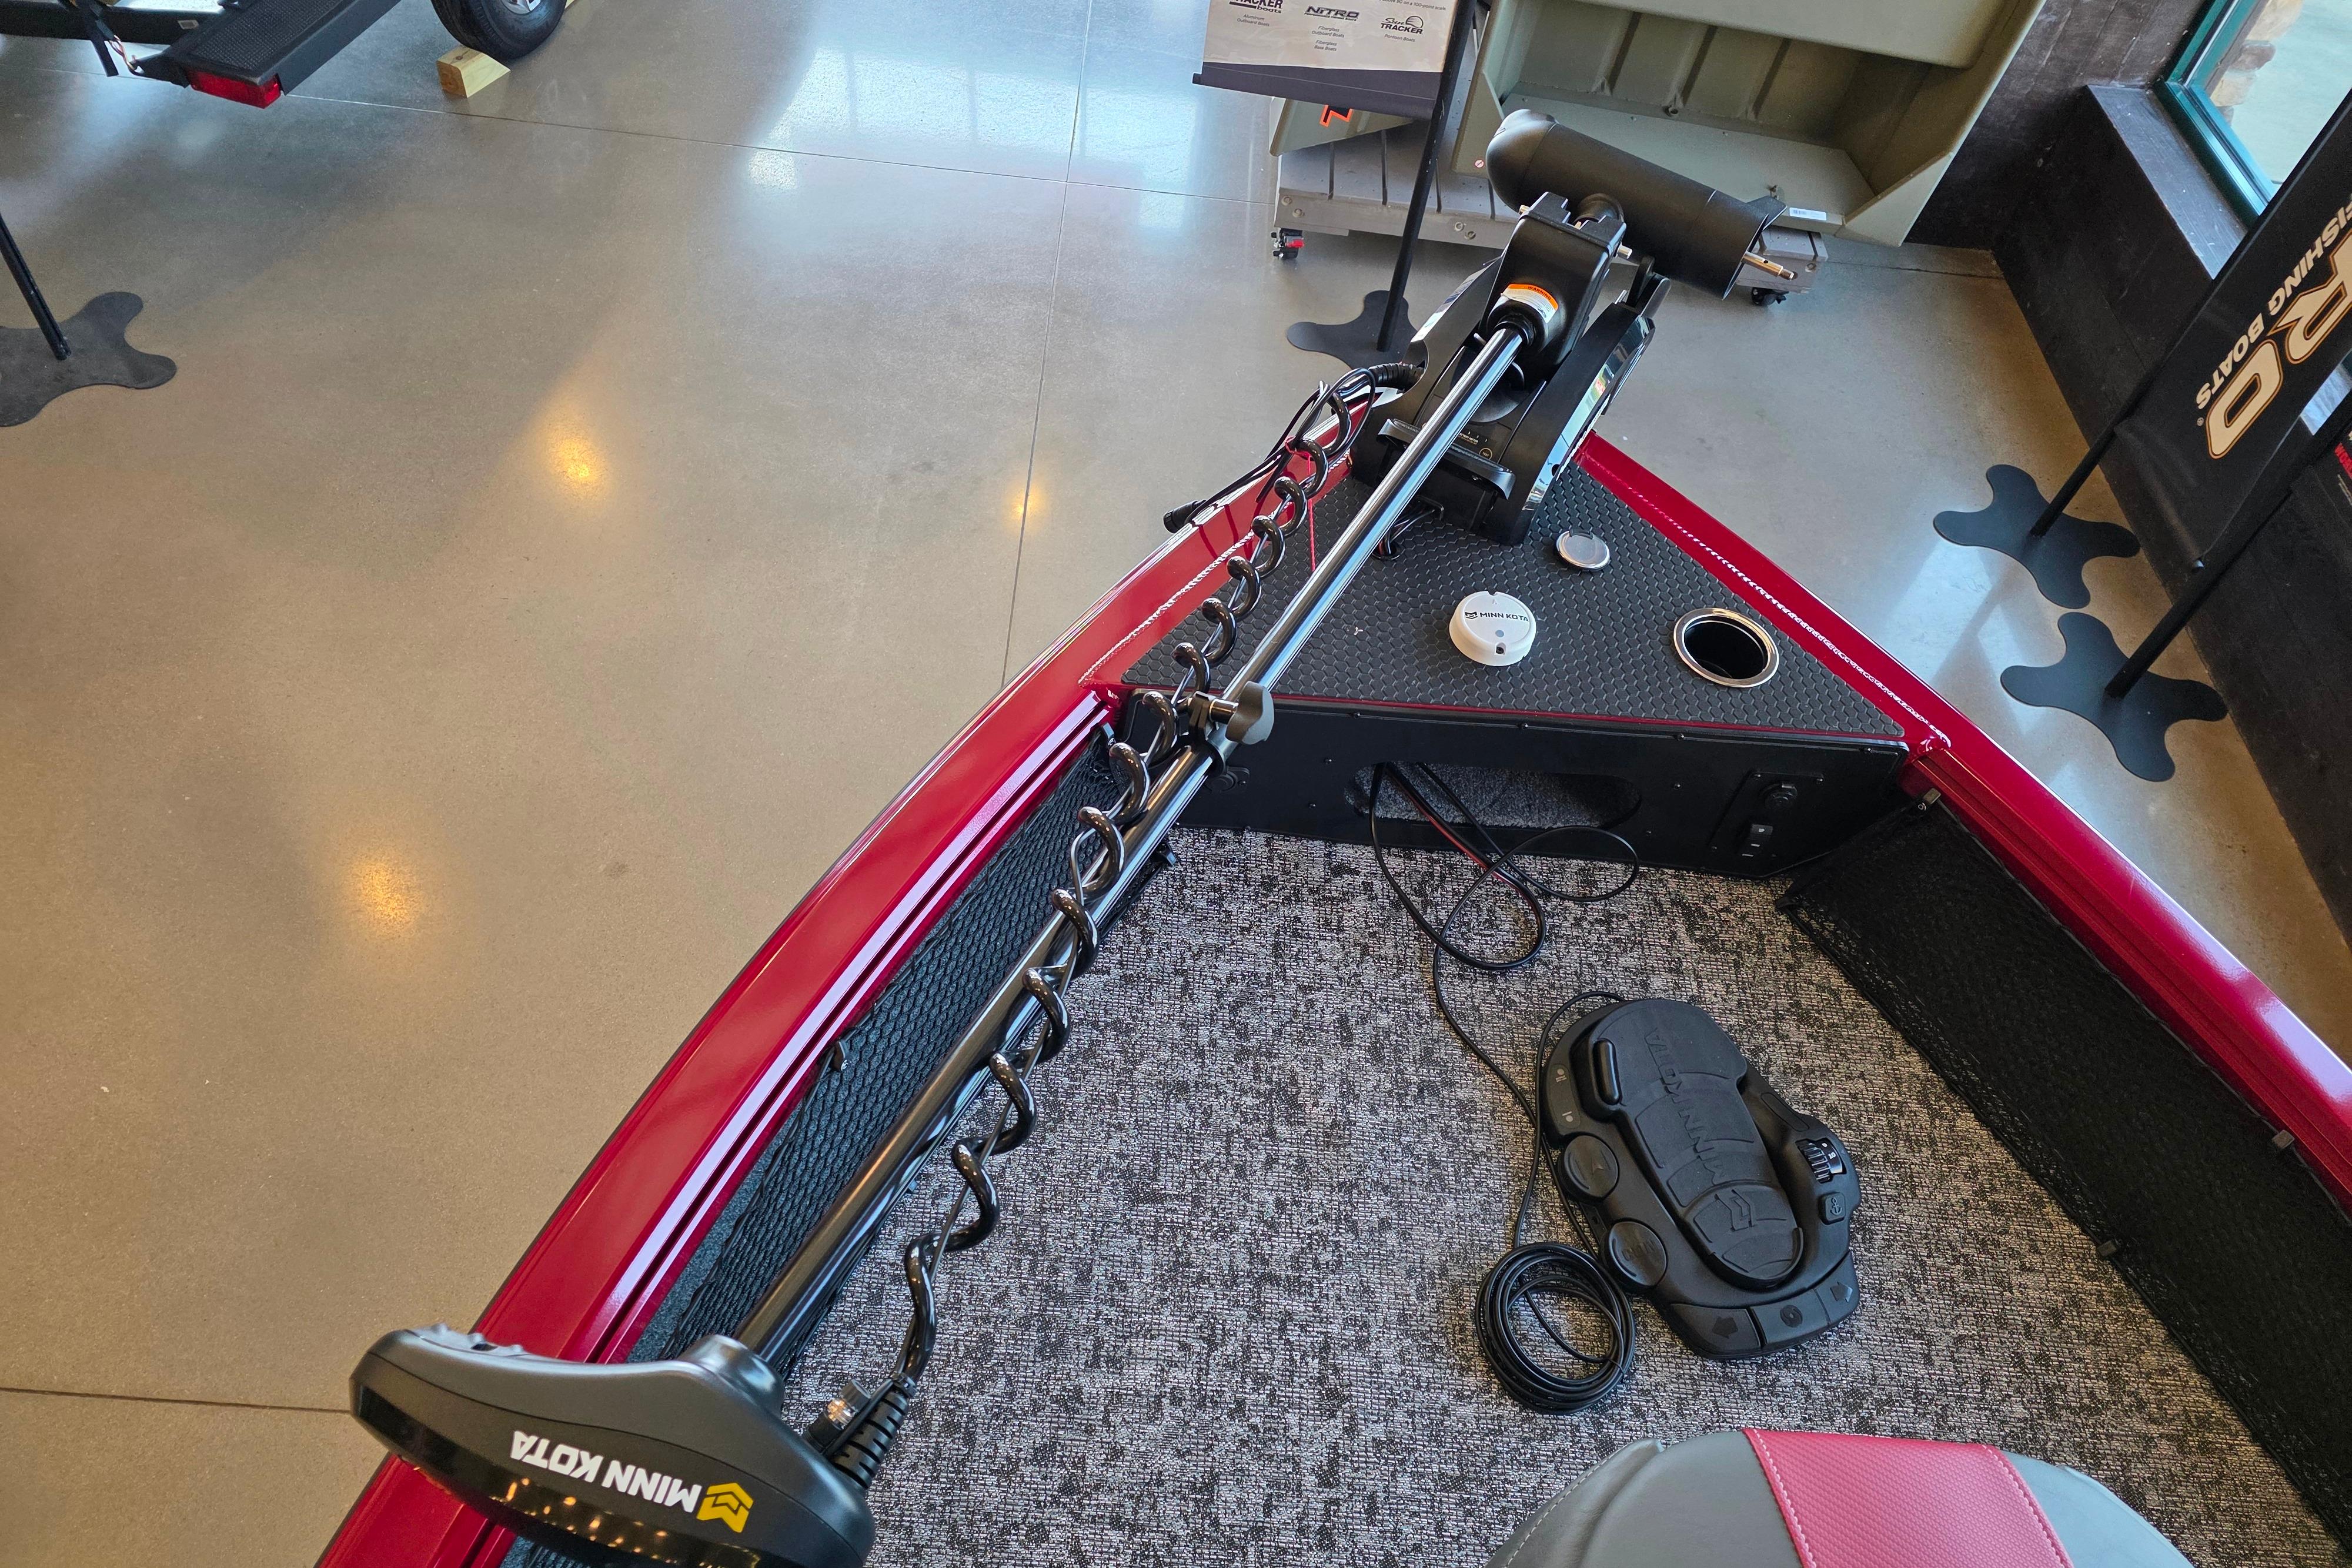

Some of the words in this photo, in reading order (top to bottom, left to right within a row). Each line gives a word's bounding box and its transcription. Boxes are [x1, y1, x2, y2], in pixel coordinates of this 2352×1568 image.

[1381, 23, 1423, 35] TRACKER
[1528, 286, 1551, 300] WARNING
[2196, 312, 2264, 410] BOATS
[1506, 613, 1529, 622] KOTA
[510, 1430, 603, 1483] KOTA
[602, 1460, 702, 1513] MINN
